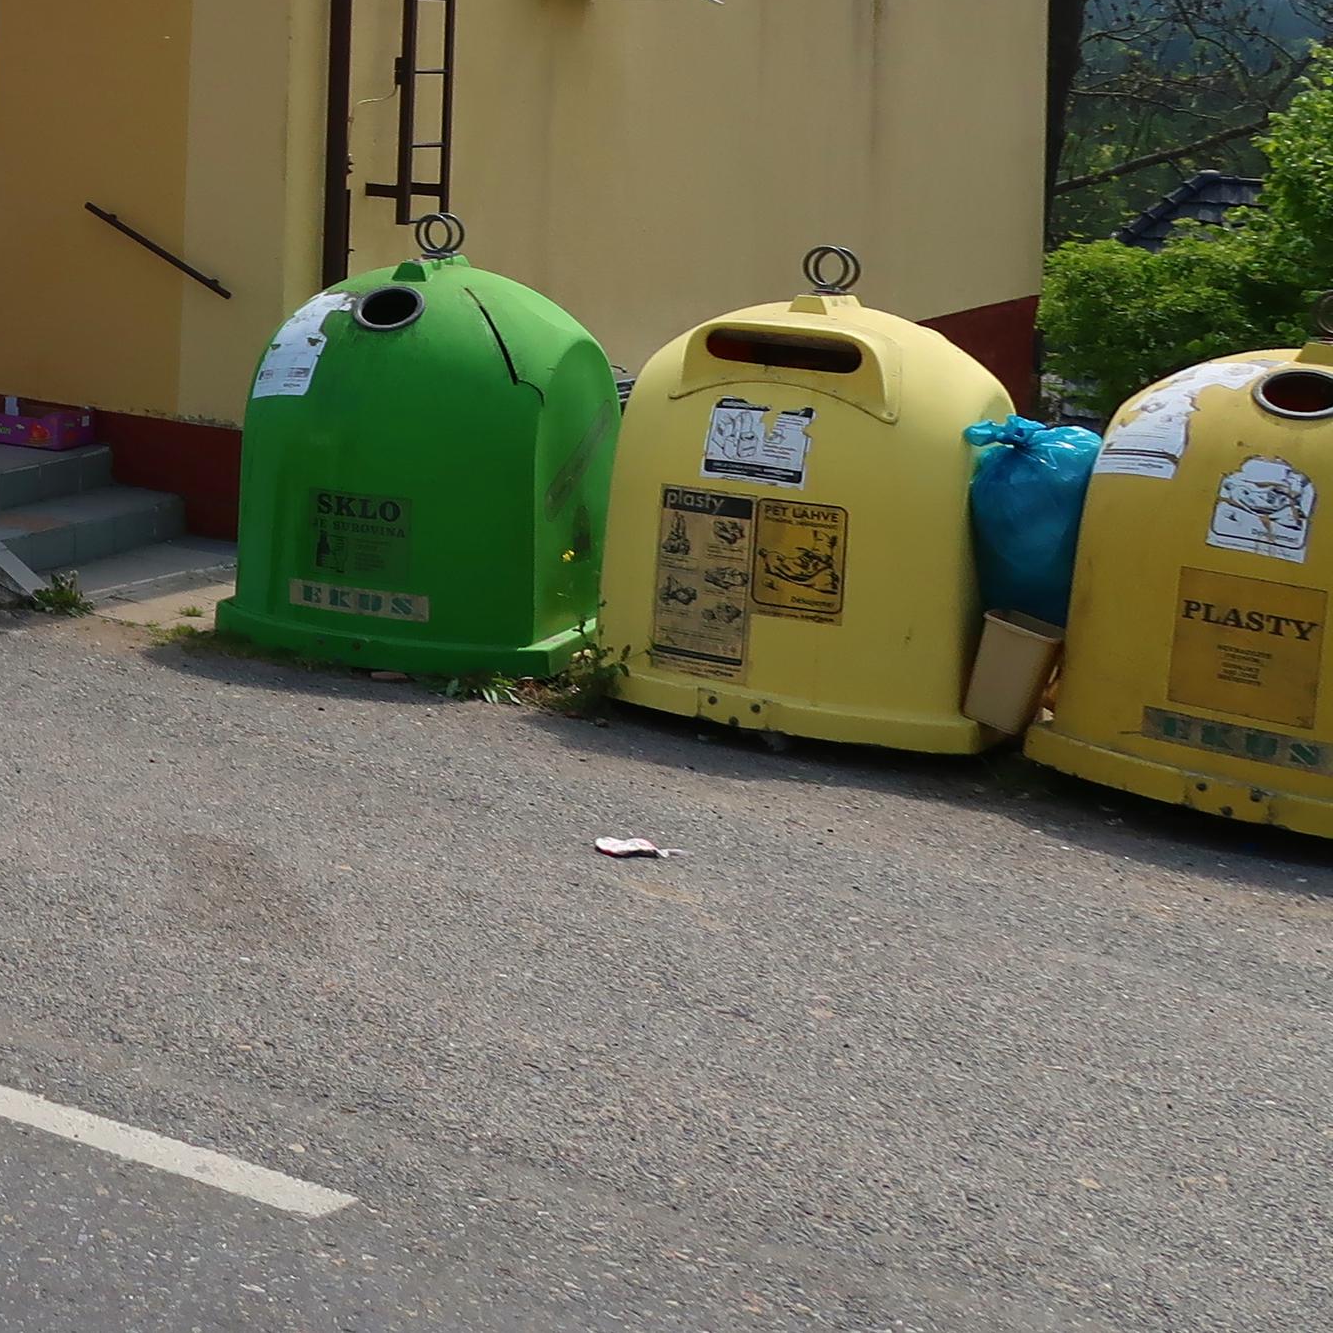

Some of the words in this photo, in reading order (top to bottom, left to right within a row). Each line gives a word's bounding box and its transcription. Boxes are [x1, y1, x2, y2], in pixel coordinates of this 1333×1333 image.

[316, 492, 402, 523] SKLO
[666, 488, 726, 515] plasty
[765, 504, 789, 518] PET
[332, 520, 406, 539] SUROVINA
[1182, 599, 1319, 642] PLASTY
